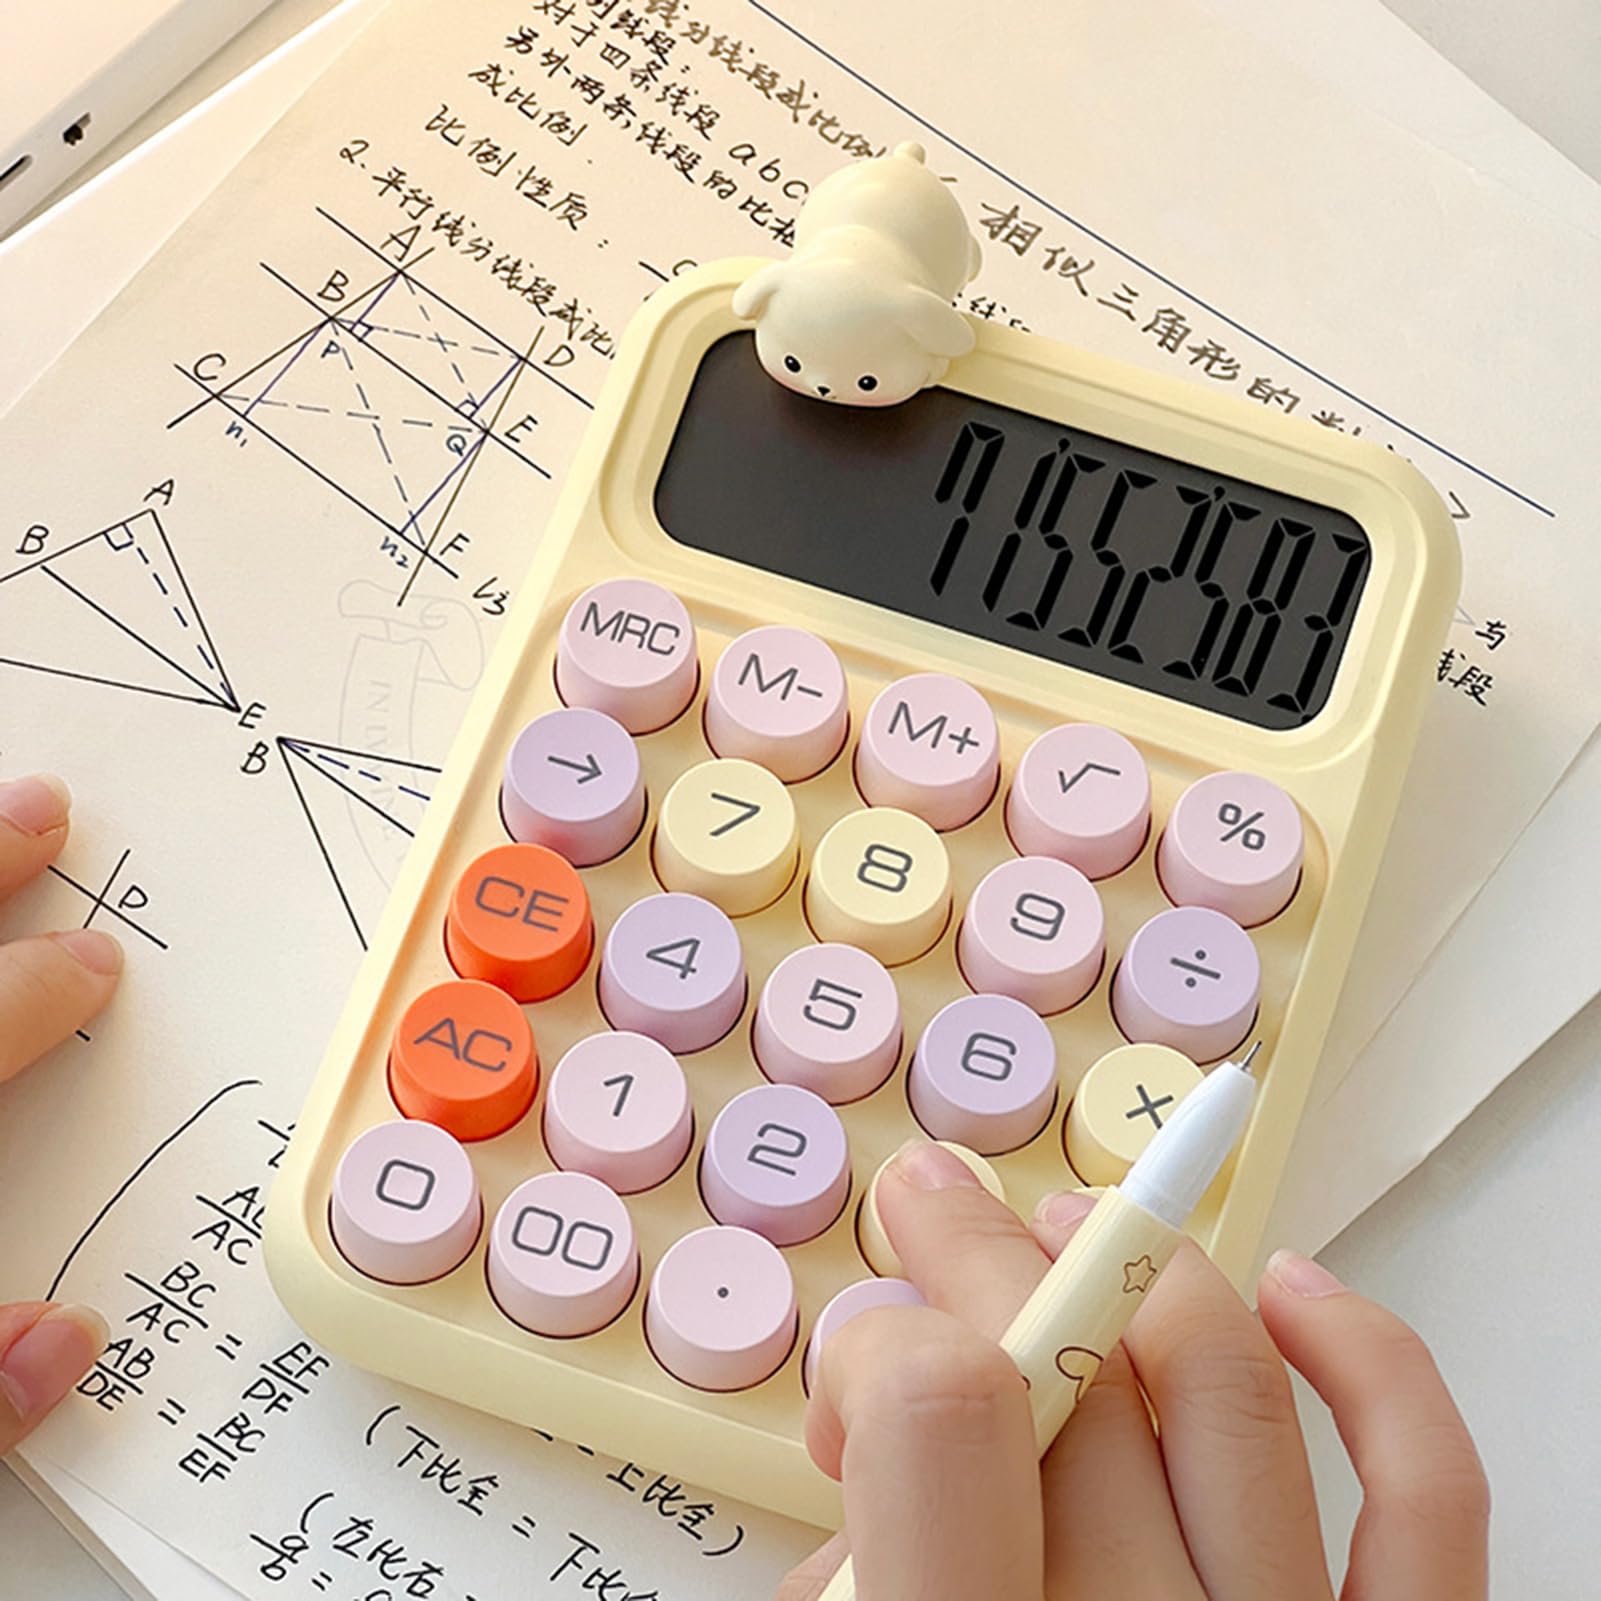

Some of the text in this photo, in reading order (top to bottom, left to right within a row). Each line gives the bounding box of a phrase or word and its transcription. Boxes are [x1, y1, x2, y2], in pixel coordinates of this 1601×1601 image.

[372, 166, 616, 361] 平行线分线段成比
[379, 224, 422, 262] A
[317, 269, 350, 303] B
[192, 352, 227, 382] C
[543, 345, 576, 369] D
[503, 413, 539, 444] E
[143, 477, 175, 506] A
[15, 524, 50, 555] B
[439, 532, 471, 556] F
[578, 600, 683, 658] MRC
[237, 701, 267, 730] E
[887, 700, 981, 755] M+
[239, 741, 270, 775] B
[709, 790, 761, 838] 7
[1216, 802, 1267, 853] %
[856, 843, 914, 895] 8
[472, 874, 571, 934] CE
[1008, 891, 1067, 942] 9
[645, 936, 702, 981] 4
[801, 977, 863, 1033] 5
[413, 1016, 514, 1075] AC
[959, 1031, 1019, 1083] 6
[601, 1072, 637, 1118] 1
[746, 1122, 808, 1178] 2
[192, 1218, 253, 1266] AC
[160, 1261, 217, 1309] BC
[104, 1336, 156, 1382] AB
[126, 1302, 190, 1344] AC
[272, 1341, 330, 1380] EF
[76, 1370, 126, 1412] DE
[215, 1412, 266, 1455] BC
[242, 1377, 294, 1415] DF
[178, 1449, 232, 1482] EF
